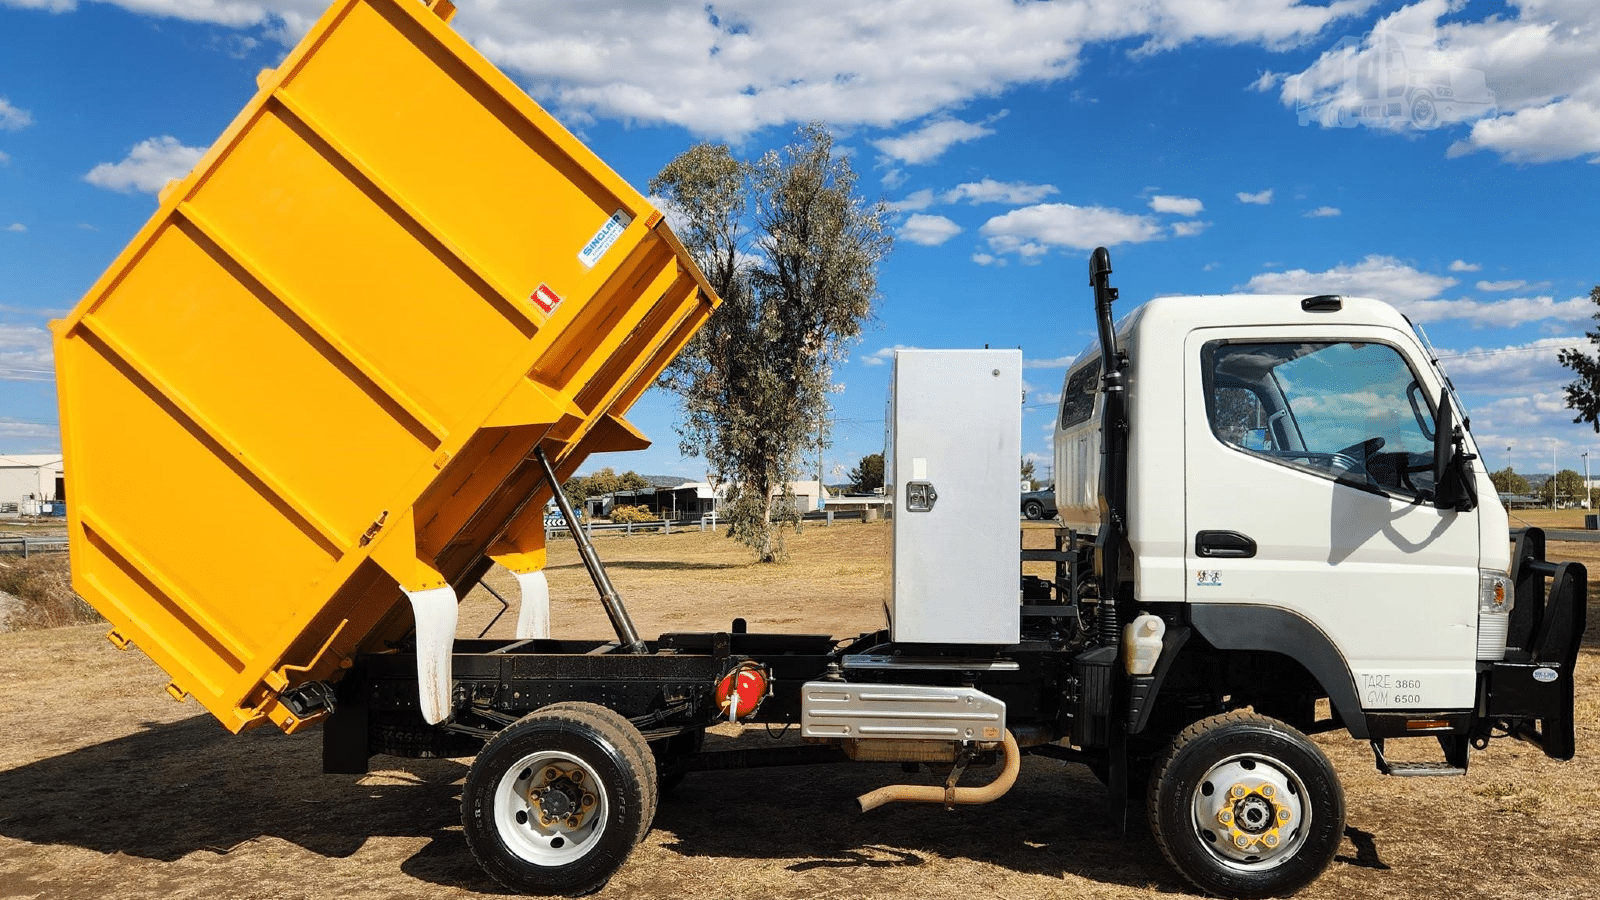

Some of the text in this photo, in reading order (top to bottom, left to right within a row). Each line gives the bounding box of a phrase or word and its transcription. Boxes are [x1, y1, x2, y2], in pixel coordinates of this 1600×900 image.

[583, 214, 621, 256] SINCLAIR
[1361, 674, 1421, 689] TARE 3860
[1368, 690, 1421, 706] GVM 6500
